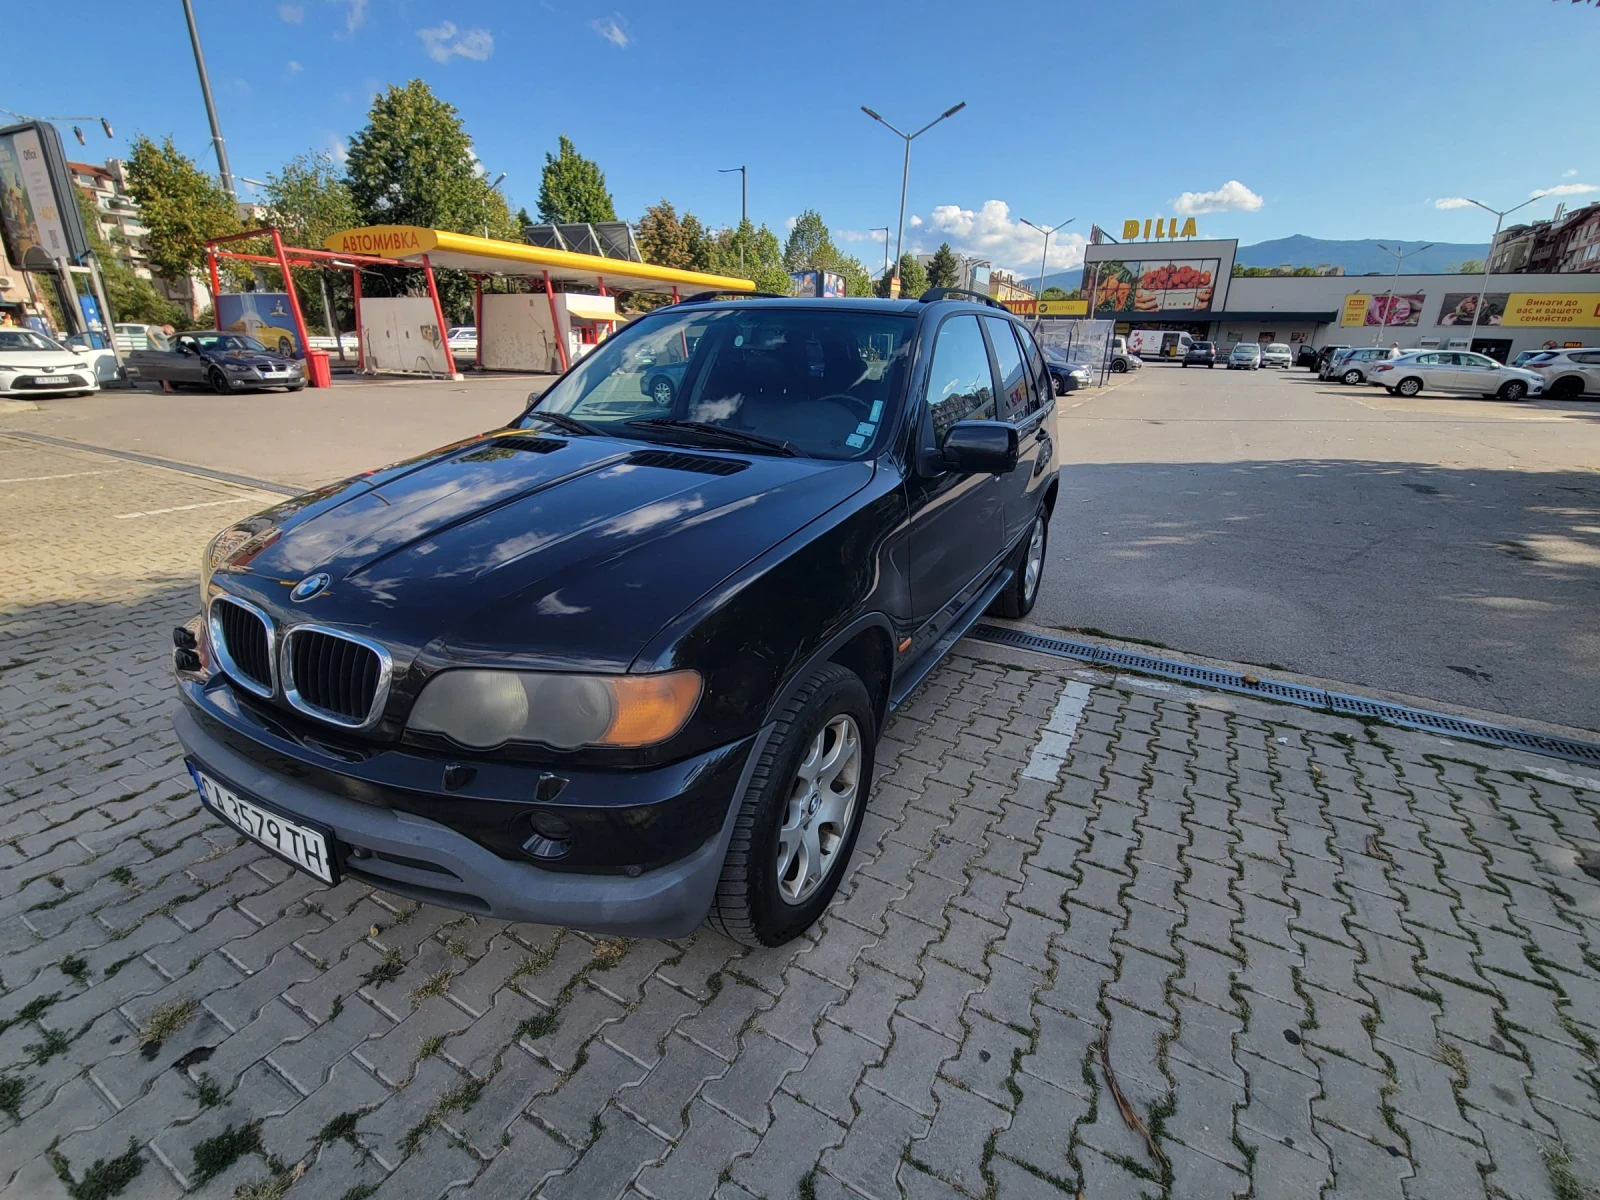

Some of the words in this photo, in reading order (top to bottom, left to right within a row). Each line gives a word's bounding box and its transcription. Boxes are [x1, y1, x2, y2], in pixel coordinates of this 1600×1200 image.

[1122, 217, 1197, 239] BILLA
[342, 231, 420, 252] АВТОМИВКА
[1520, 314, 1573, 322] семейство
[228, 795, 281, 849] 3579
[285, 826, 323, 873] TH
